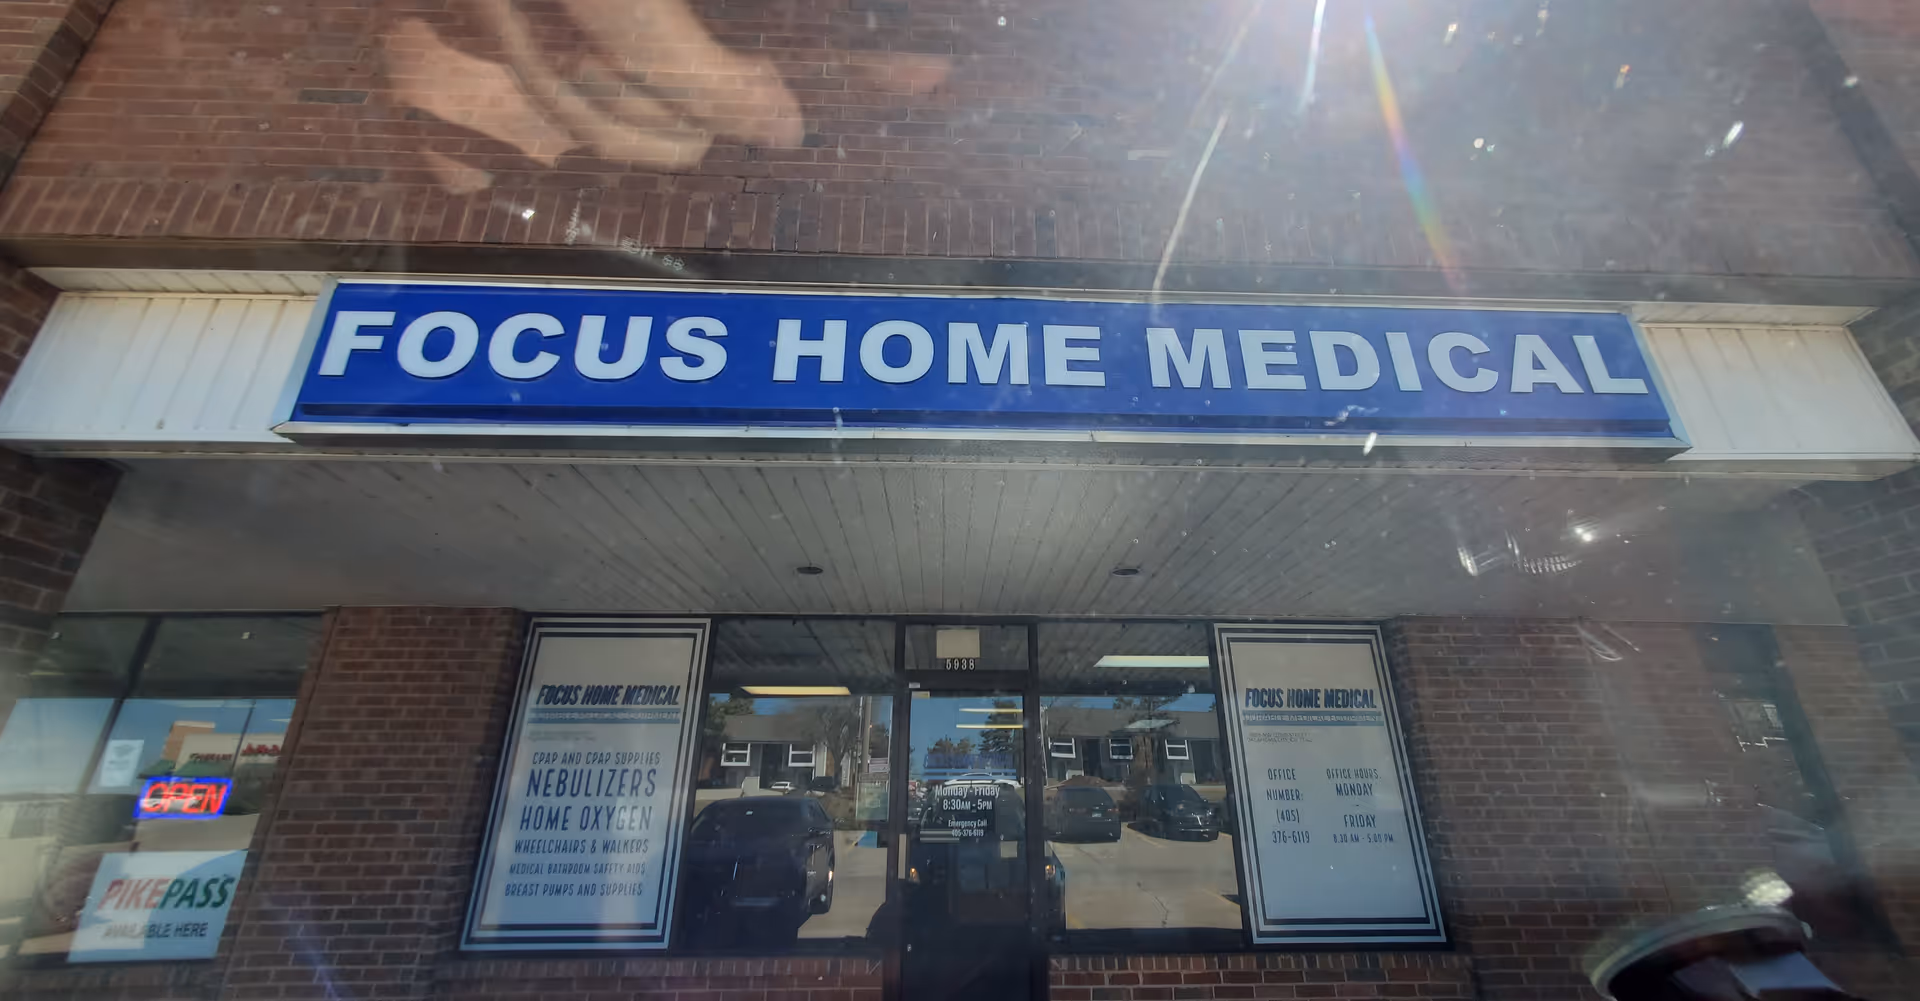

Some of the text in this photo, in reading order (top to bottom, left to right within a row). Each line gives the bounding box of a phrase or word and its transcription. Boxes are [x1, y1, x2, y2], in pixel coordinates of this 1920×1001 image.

[318, 310, 1649, 395] FOCUS HOME MEDICAL
[945, 658, 976, 671] 5938
[536, 684, 681, 706] FOCUS HOME MEDICAL
[1245, 687, 1377, 708] FOCUS HOME MEDICAL
[532, 752, 661, 765] CPAP AND CPAP SUPPLIES
[1267, 768, 1296, 781] OFFICE
[1326, 768, 1352, 780] OFFICE
[525, 768, 657, 797] NEBULIZERS
[1335, 782, 1373, 797] MONDAY
[144, 782, 228, 814] OPEN
[934, 785, 968, 799] Monday
[974, 786, 1000, 799] Friday
[1266, 789, 1304, 801] NUMBER:
[943, 799, 971, 811] 8:30AM
[977, 799, 993, 810] 5PM
[519, 805, 652, 831] HOME OXYGEN
[1276, 808, 1300, 824] (405)
[1343, 814, 1376, 828] FRIDAY
[948, 819, 988, 828] Emergency Call
[1272, 830, 1310, 844] 376-6119
[1350, 833, 1360, 843] AM
[1383, 832, 1394, 843] PM
[514, 839, 649, 854] WHEELCHAIRS & WALKERS
[509, 863, 645, 875] MEDICAL BATHROOM SAFETY AIDS
[97, 877, 236, 910] PIKEPASS
[504, 883, 643, 897] BREAST PUMPS AND SUPPLIES
[173, 921, 209, 937] HERE
